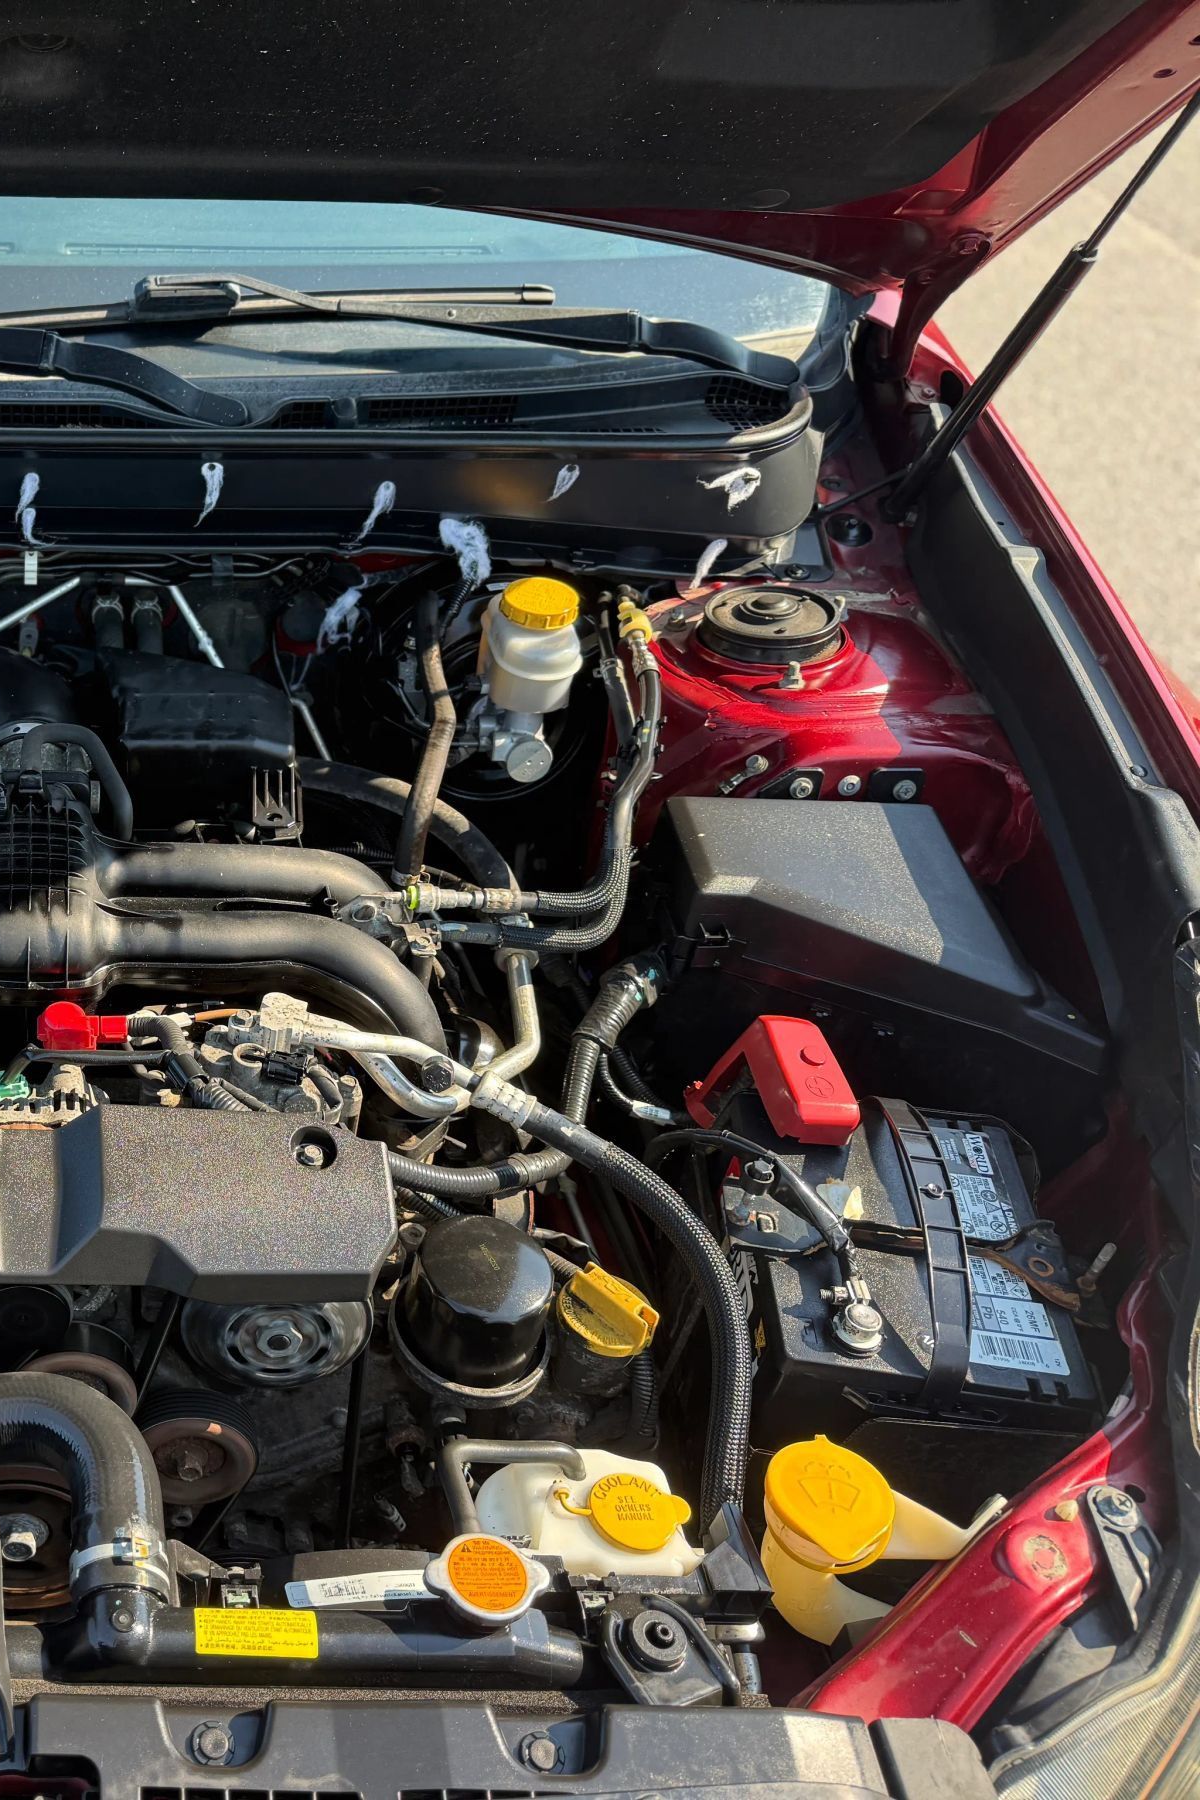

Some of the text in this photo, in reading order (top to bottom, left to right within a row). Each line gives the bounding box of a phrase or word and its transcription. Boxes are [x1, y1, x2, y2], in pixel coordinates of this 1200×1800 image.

[968, 1136, 989, 1173] WORLD
[1005, 1211, 1019, 1236] DANG
[981, 1306, 993, 1319] Pb
[997, 1310, 1009, 1325] 540
[1025, 1310, 1040, 1333] 26MF
[594, 1476, 662, 1500] COOLANT
[617, 1496, 637, 1504] SEE
[615, 1504, 651, 1512] OWNERS
[618, 1512, 654, 1520] MANUAL
